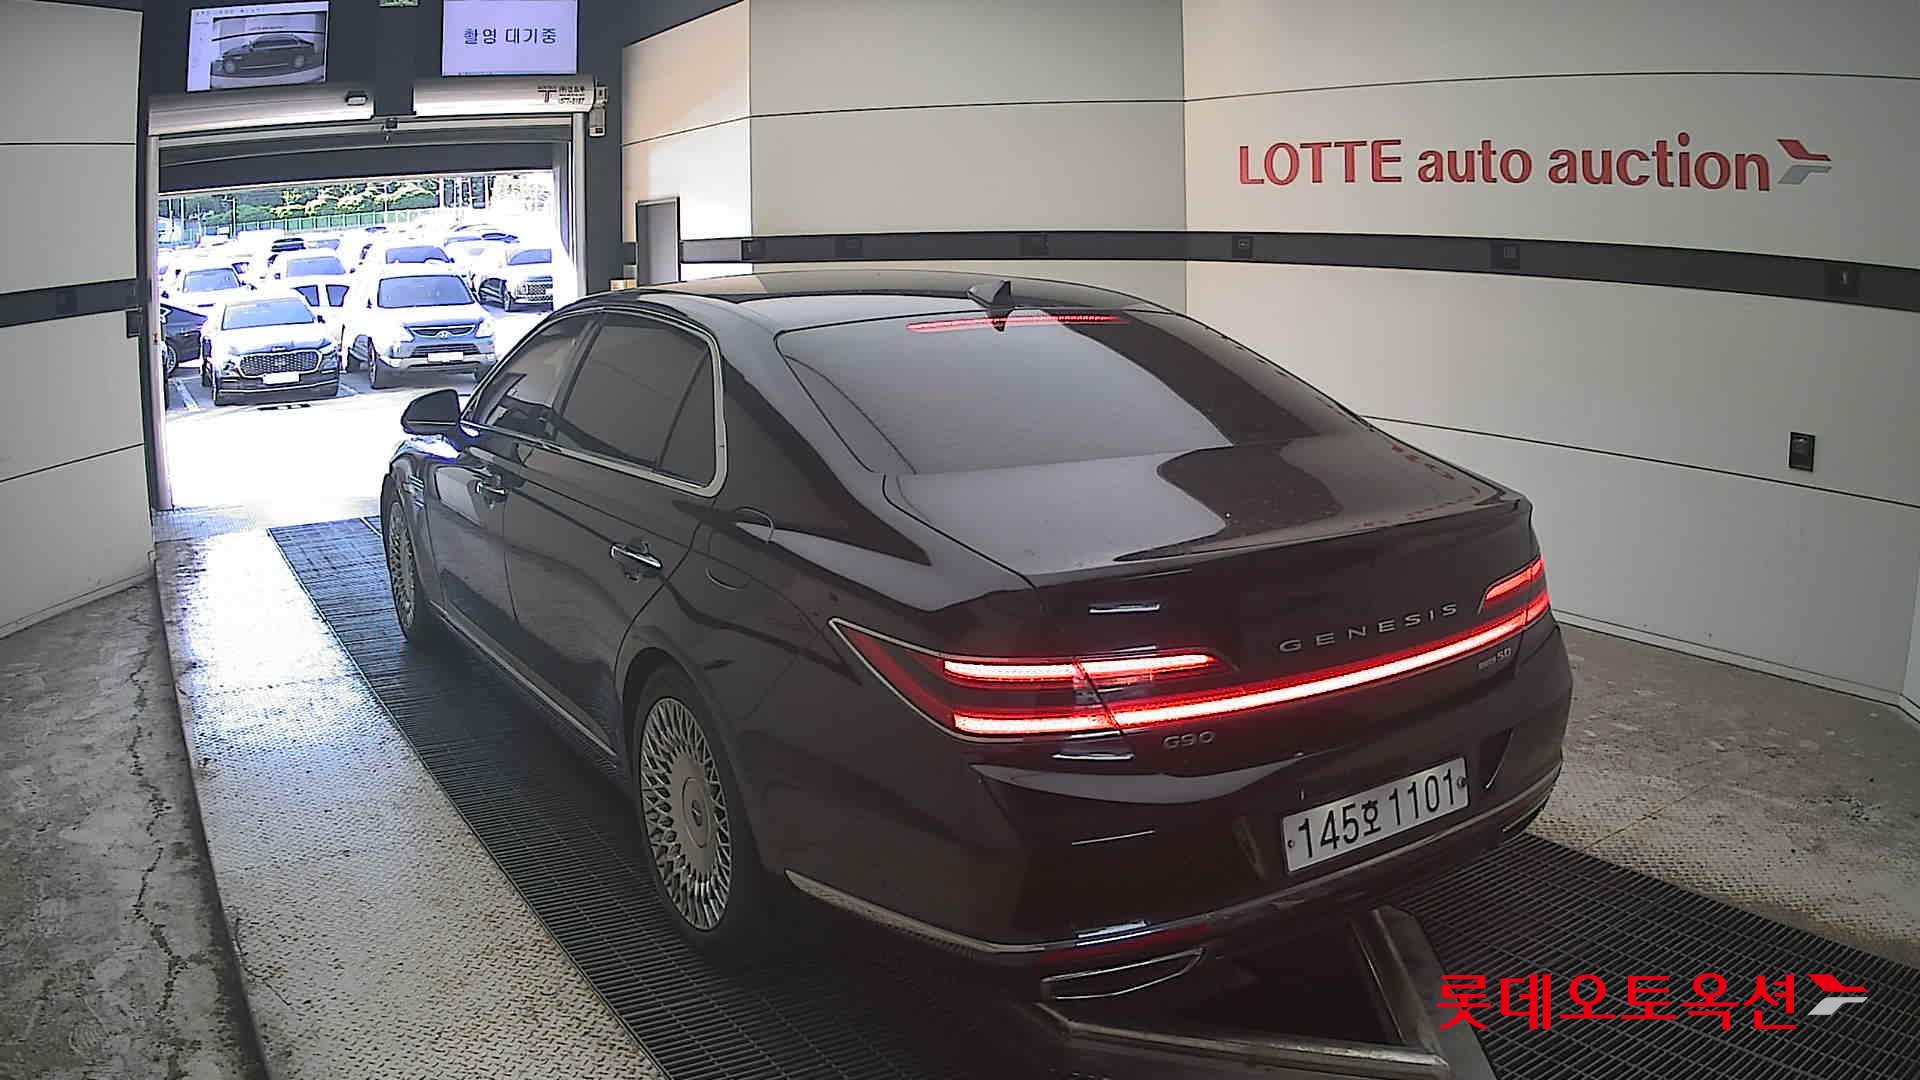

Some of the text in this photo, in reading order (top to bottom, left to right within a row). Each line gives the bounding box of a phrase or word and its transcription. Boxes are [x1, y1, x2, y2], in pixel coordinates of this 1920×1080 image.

[504, 27, 557, 44] 대기중
[1239, 132, 1770, 192] LOTTE auto auction
[1278, 602, 1459, 653] GENESIS
[1162, 730, 1217, 750] G90
[1297, 767, 1457, 859] 145호 1101
